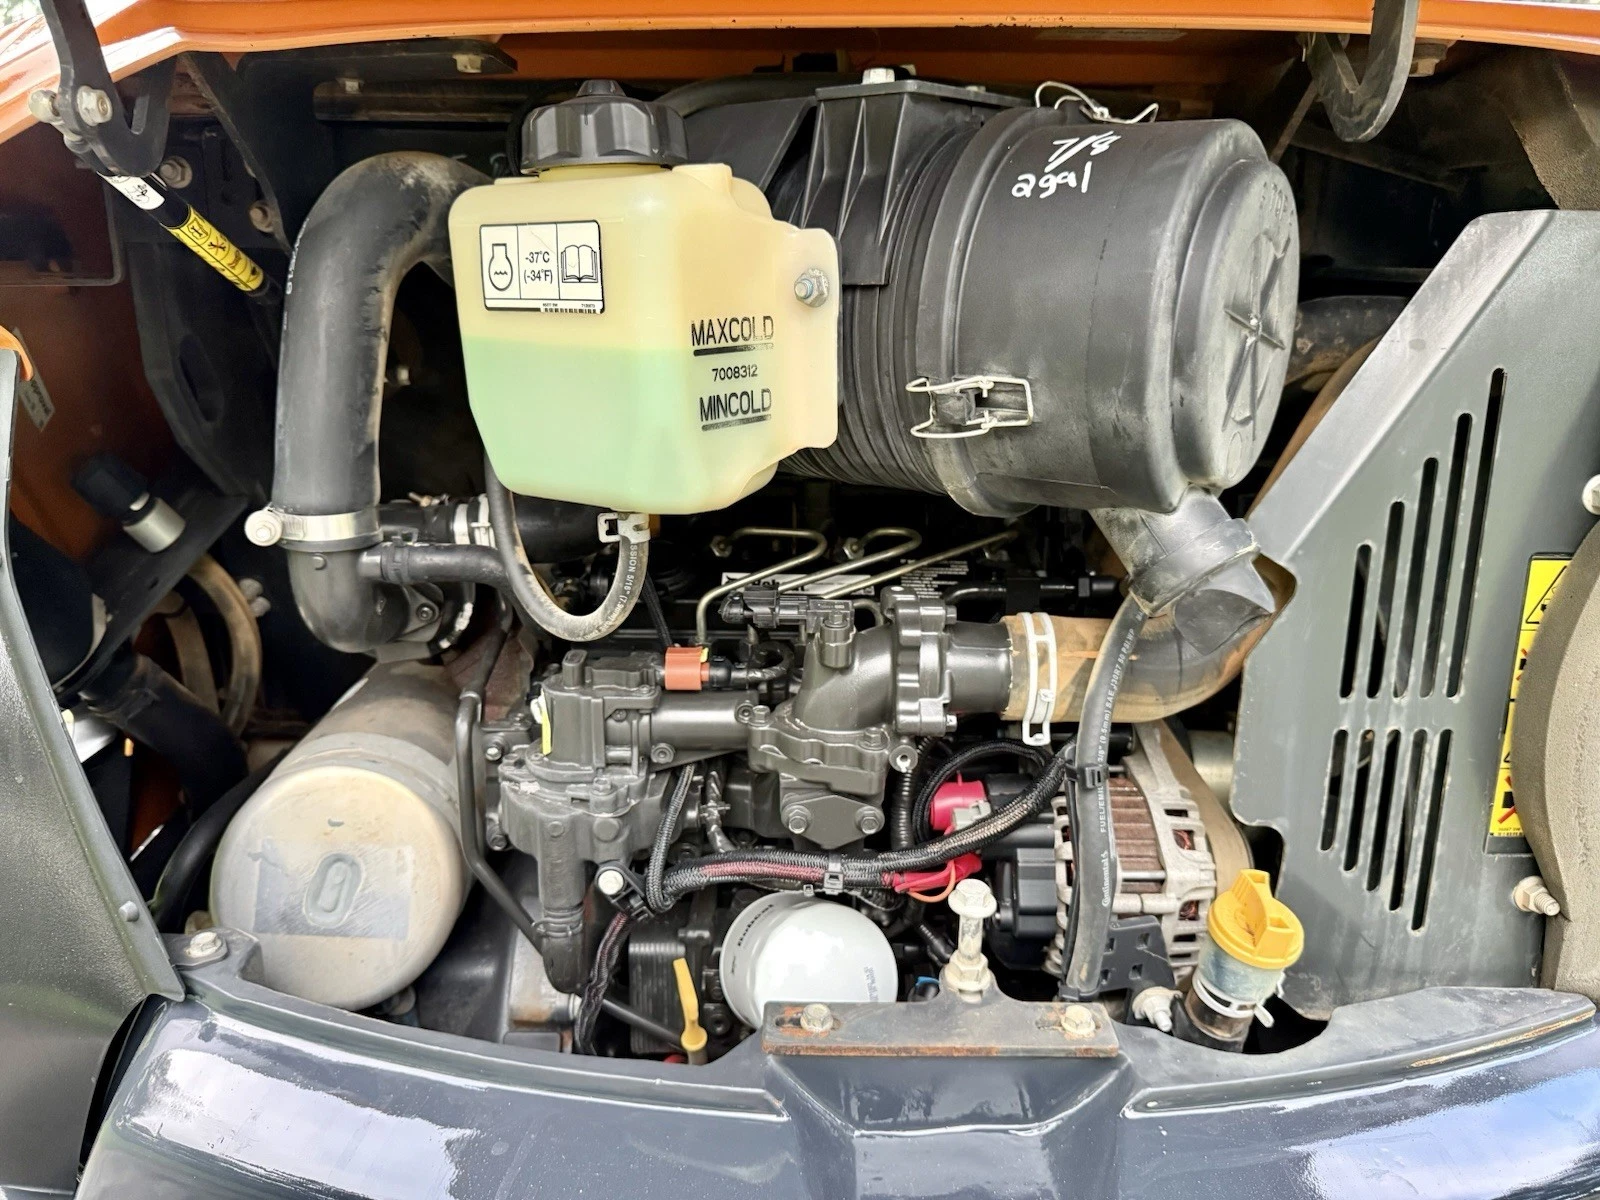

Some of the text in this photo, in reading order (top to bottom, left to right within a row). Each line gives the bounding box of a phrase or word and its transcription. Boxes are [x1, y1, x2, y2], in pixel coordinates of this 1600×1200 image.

[1044, 130, 1122, 173] 7/8
[523, 268, 553, 284] (-34°F)
[711, 363, 759, 382] 7008312
[627, 544, 638, 573] SSION
